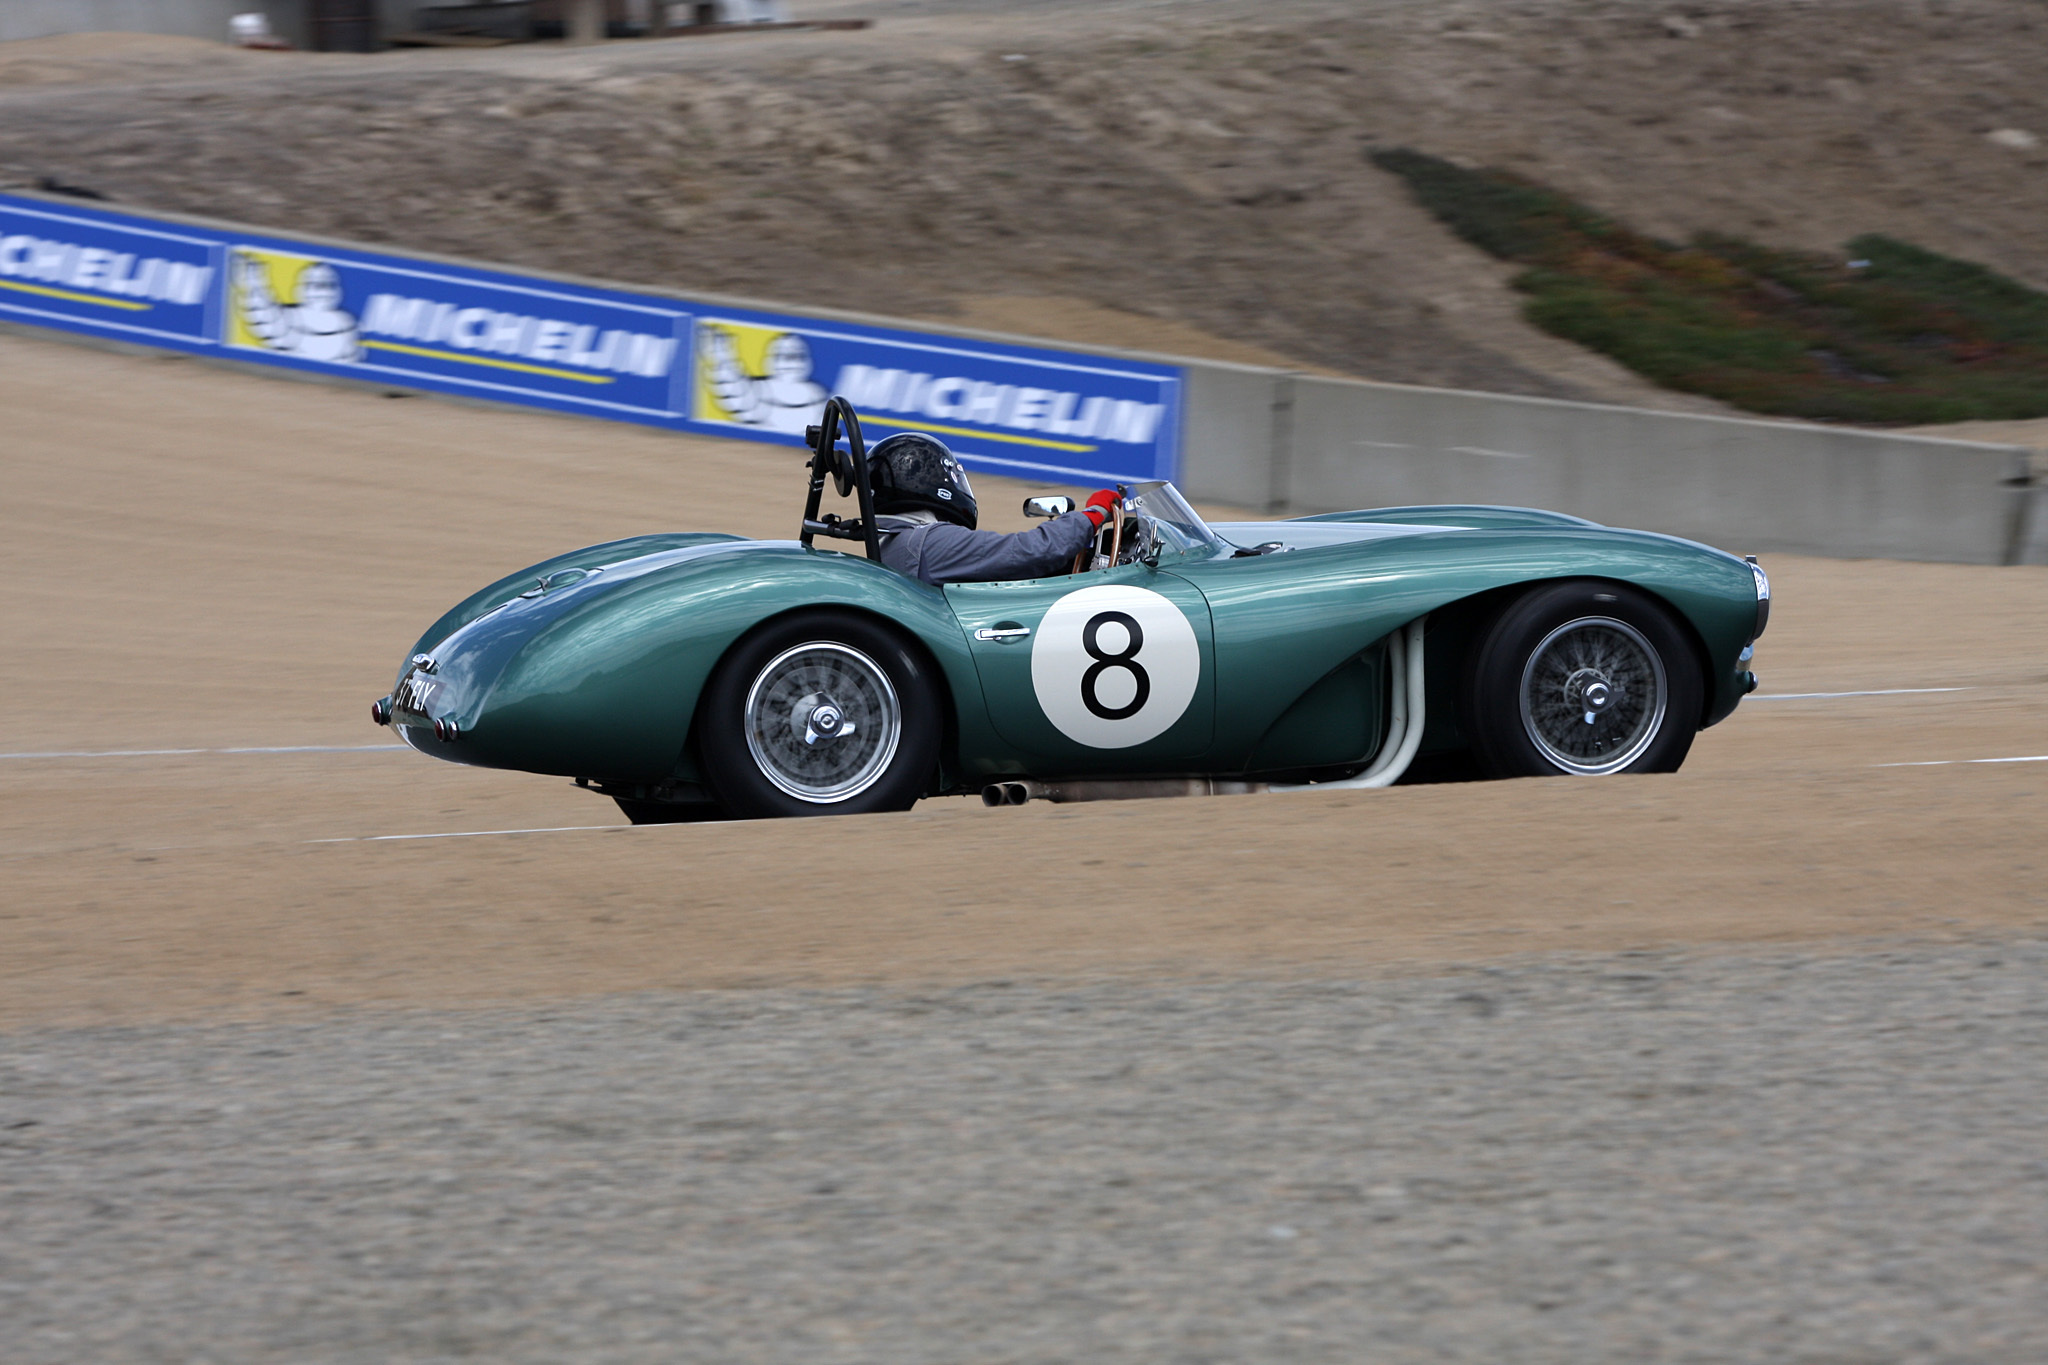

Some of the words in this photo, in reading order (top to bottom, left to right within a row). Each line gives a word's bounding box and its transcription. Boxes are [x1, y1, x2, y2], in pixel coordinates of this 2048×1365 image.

[360, 294, 680, 377] MICHELIN
[833, 364, 1166, 443] MICHELIN
[408, 680, 436, 711] FLY
[1081, 611, 1150, 720] 8
